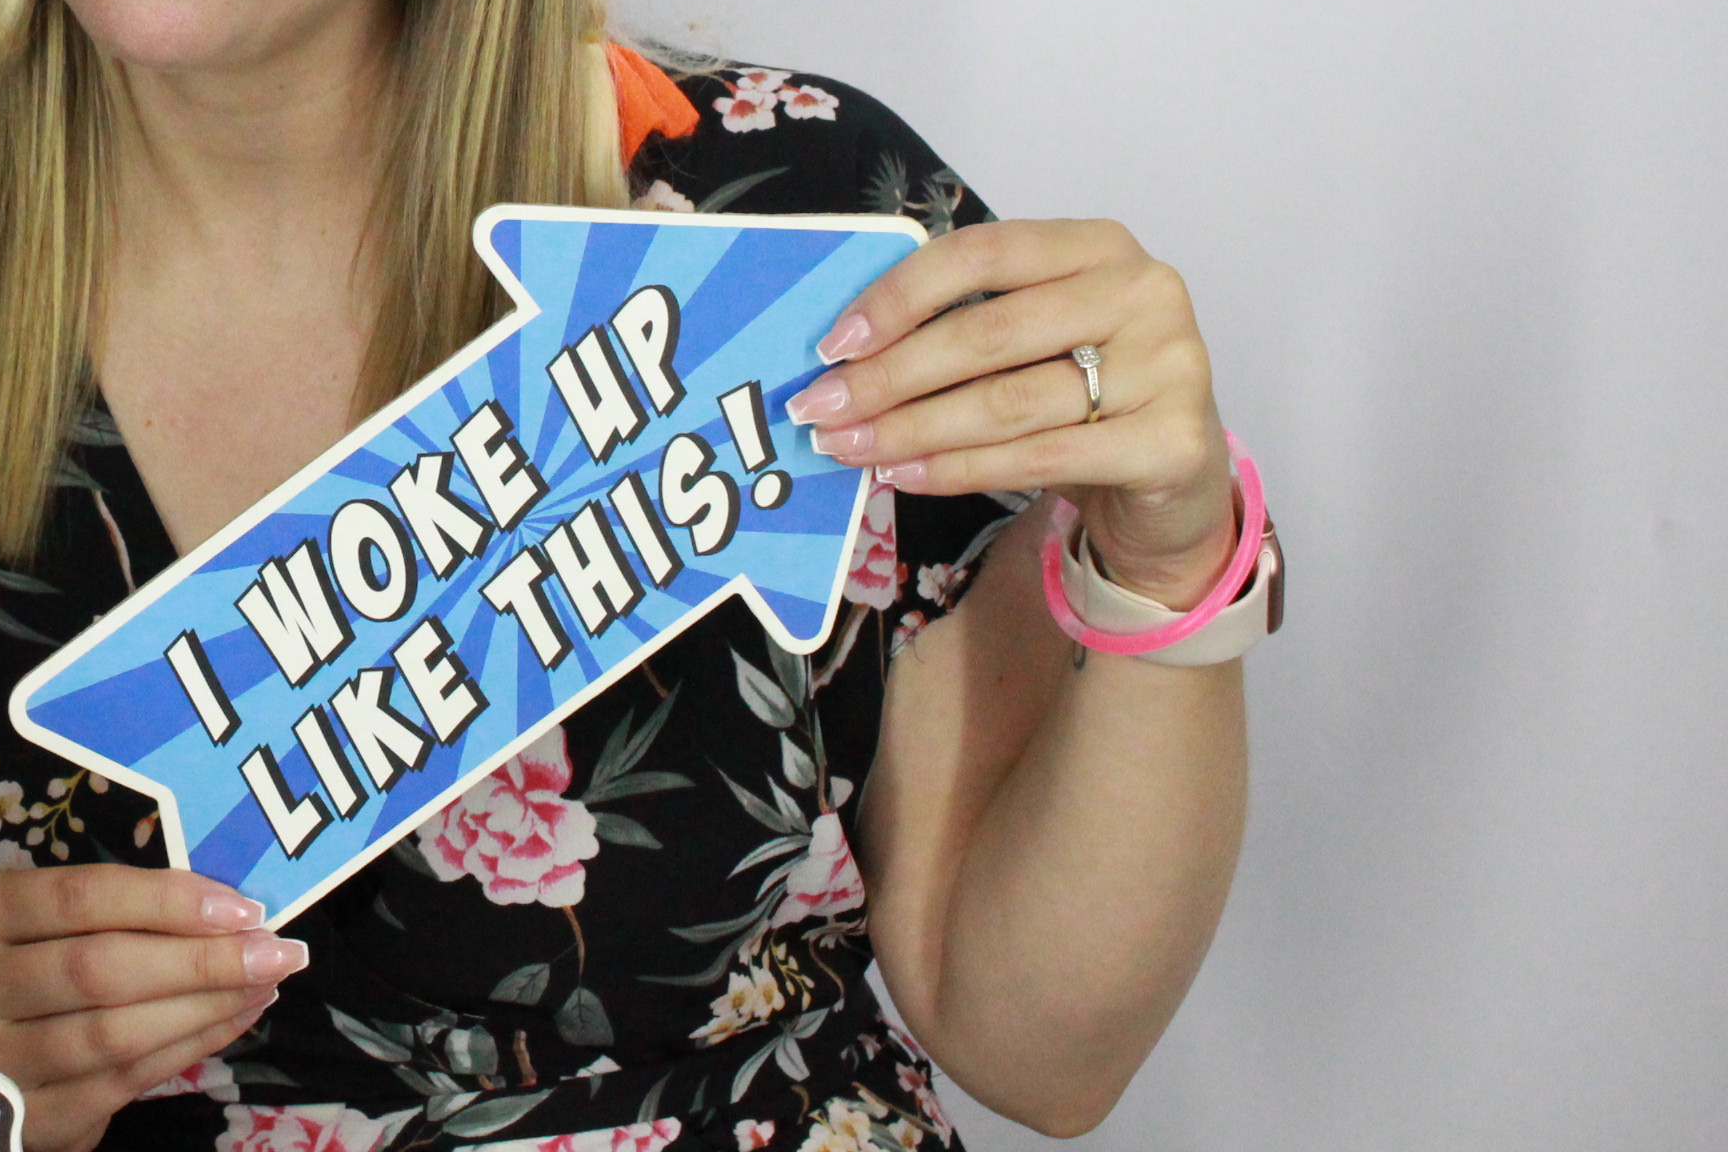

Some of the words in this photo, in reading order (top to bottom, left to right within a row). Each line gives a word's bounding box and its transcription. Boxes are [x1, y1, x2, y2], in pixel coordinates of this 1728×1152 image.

[165, 629, 242, 745] I
[234, 399, 550, 689] WOKE
[547, 284, 687, 466] UP
[237, 615, 490, 860] LIKE
[479, 380, 793, 671] THIS!
